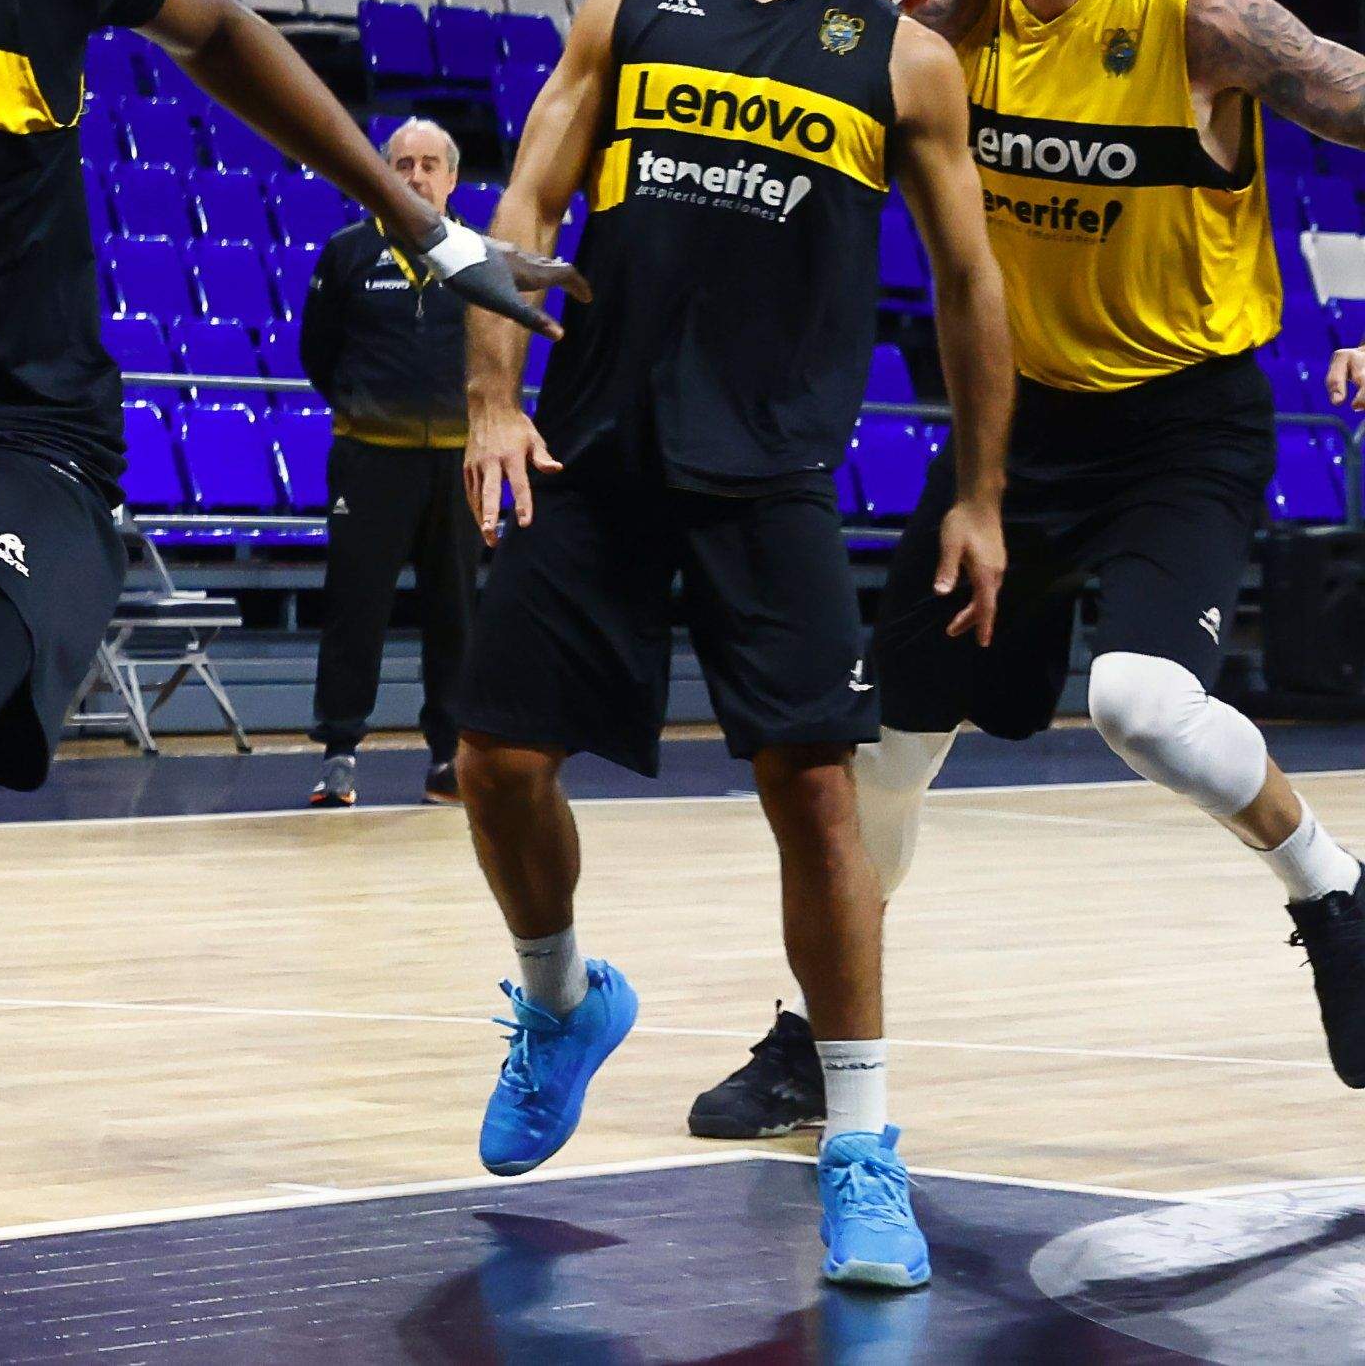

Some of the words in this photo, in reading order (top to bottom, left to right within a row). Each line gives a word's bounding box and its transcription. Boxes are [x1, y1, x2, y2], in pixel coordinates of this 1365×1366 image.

[634, 71, 836, 153] Lenovo
[972, 127, 1137, 179] enovo
[983, 188, 1123, 244] enerife!
